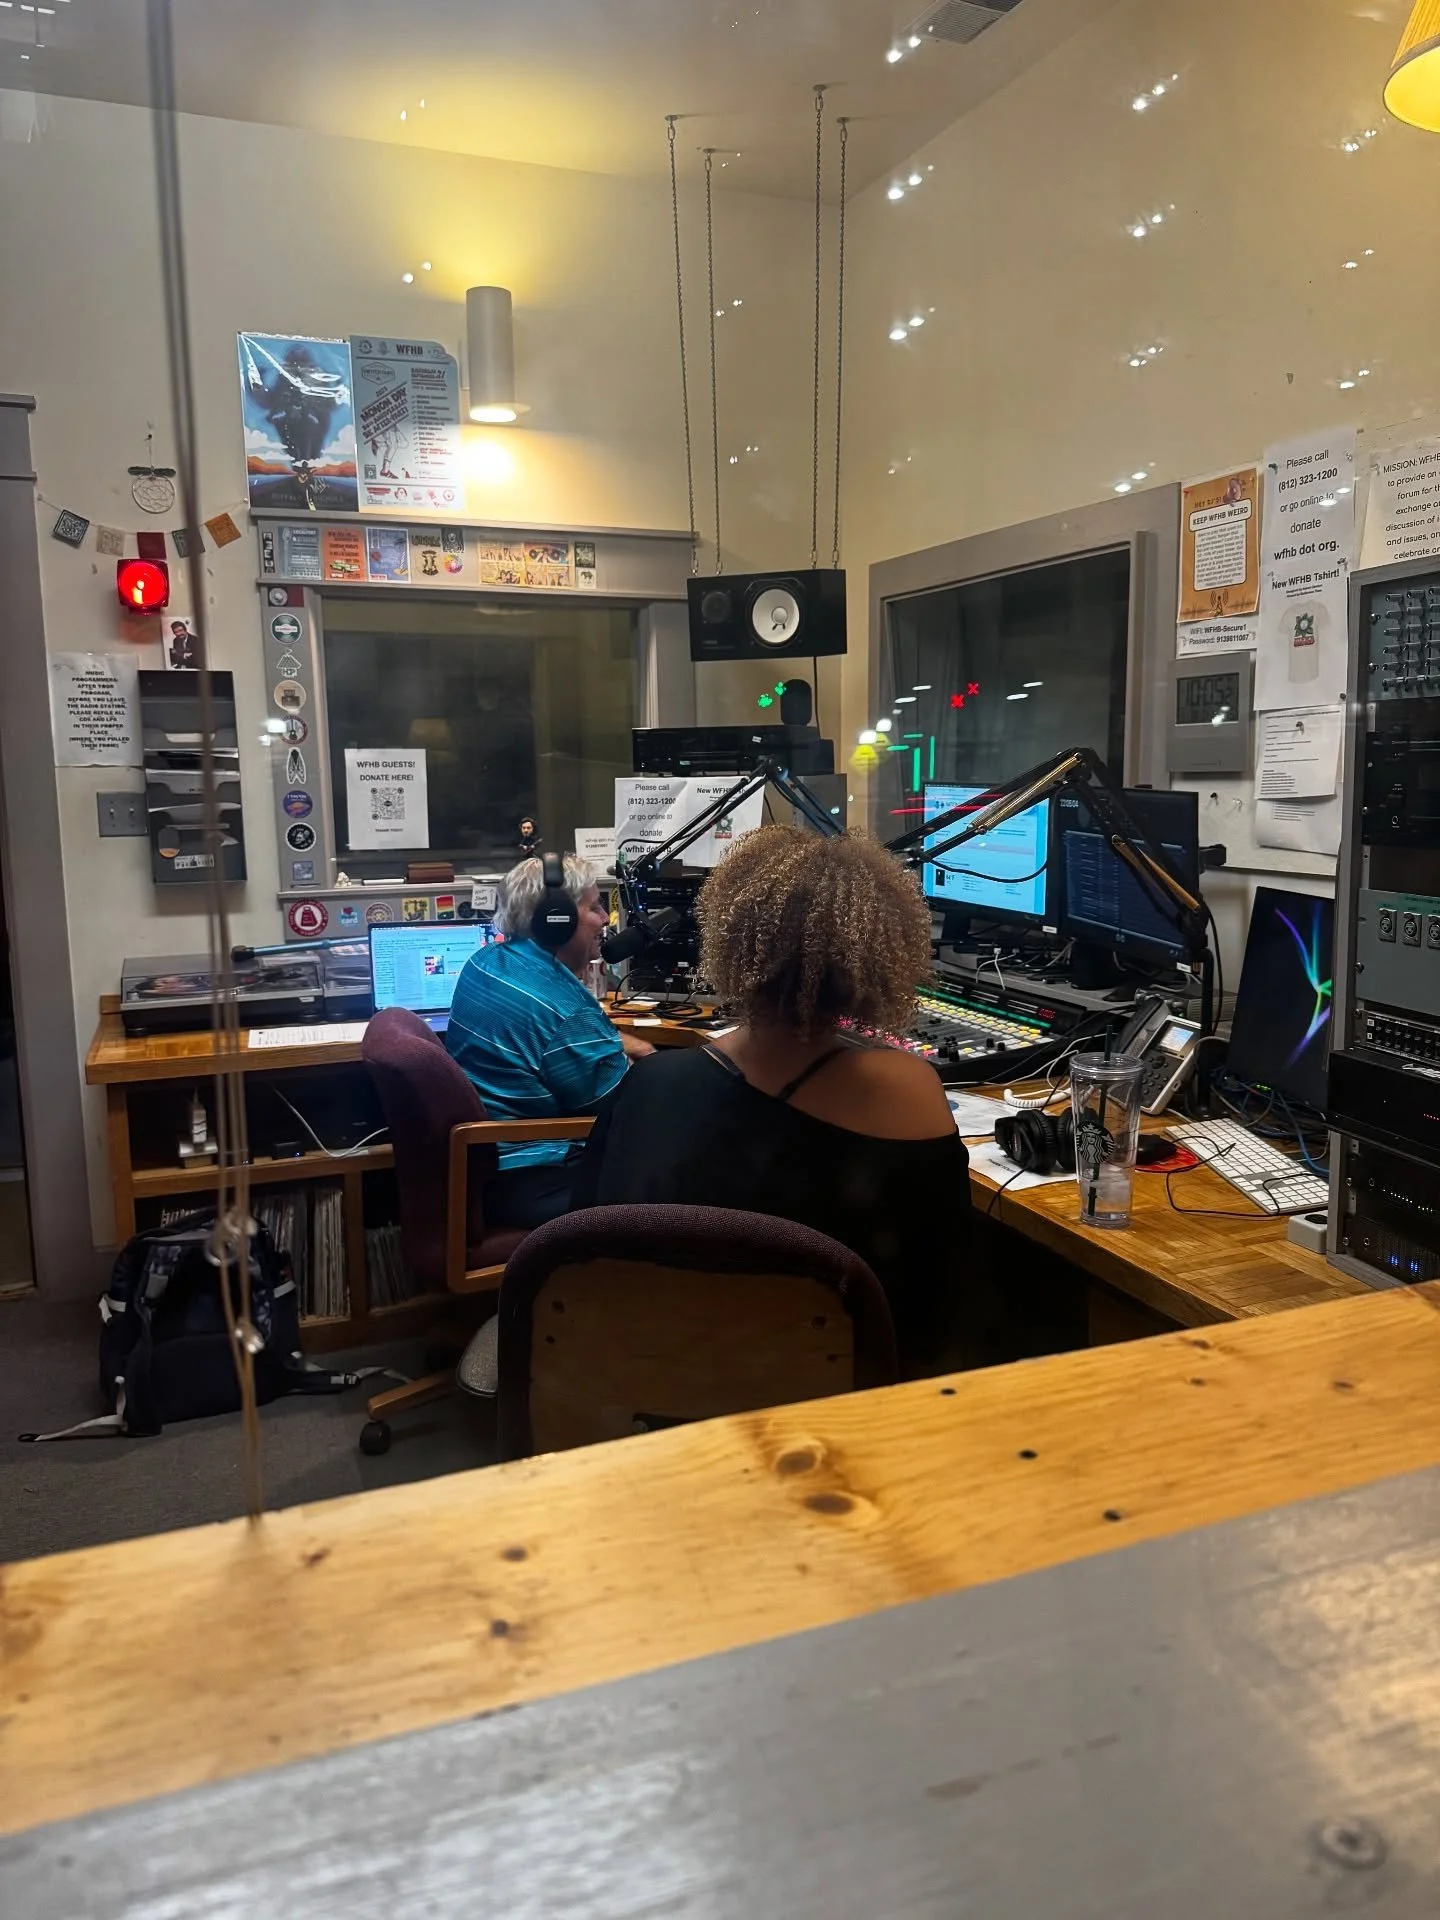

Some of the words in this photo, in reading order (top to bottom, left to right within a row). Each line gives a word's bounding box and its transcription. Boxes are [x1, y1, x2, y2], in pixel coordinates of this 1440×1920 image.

[396, 344, 424, 355] WFHB
[1286, 455, 1312, 469] Please
[1314, 449, 1329, 460] call
[1383, 458, 1417, 473] MISSION:
[1278, 478, 1297, 493] (812)
[1299, 467, 1338, 486] 323-1200
[1397, 473, 1426, 487] provide
[1427, 471, 1437, 479] an
[1397, 490, 1420, 500] forum
[1421, 486, 1433, 495] for
[1280, 504, 1288, 512] or
[1289, 501, 1299, 512] go
[1300, 495, 1324, 507] online
[1395, 502, 1431, 515] exchange
[1192, 514, 1207, 526] KEEP
[1209, 511, 1227, 522] WFHB
[1228, 506, 1249, 518] WEIRD
[1290, 518, 1322, 534] donate
[1385, 519, 1425, 531] discussion
[1426, 515, 1436, 524] of
[1386, 536, 1402, 546] and
[1403, 534, 1429, 544] issues,
[1273, 546, 1297, 560] wfhb
[1299, 542, 1316, 555] dot
[1318, 540, 1340, 552] org.
[1393, 548, 1431, 560] celebrate
[1272, 580, 1287, 590] New
[1288, 574, 1312, 586] WFHB
[1313, 568, 1340, 581] Tshirt!
[1204, 623, 1247, 634] WFHB-Secure1
[381, 760, 416, 769] GUESTS!
[634, 783, 657, 791] Please
[658, 783, 670, 791] call
[627, 797, 645, 807] (812)
[637, 814, 647, 822] go
[639, 828, 663, 837] donate
[626, 845, 645, 853] wfhb
